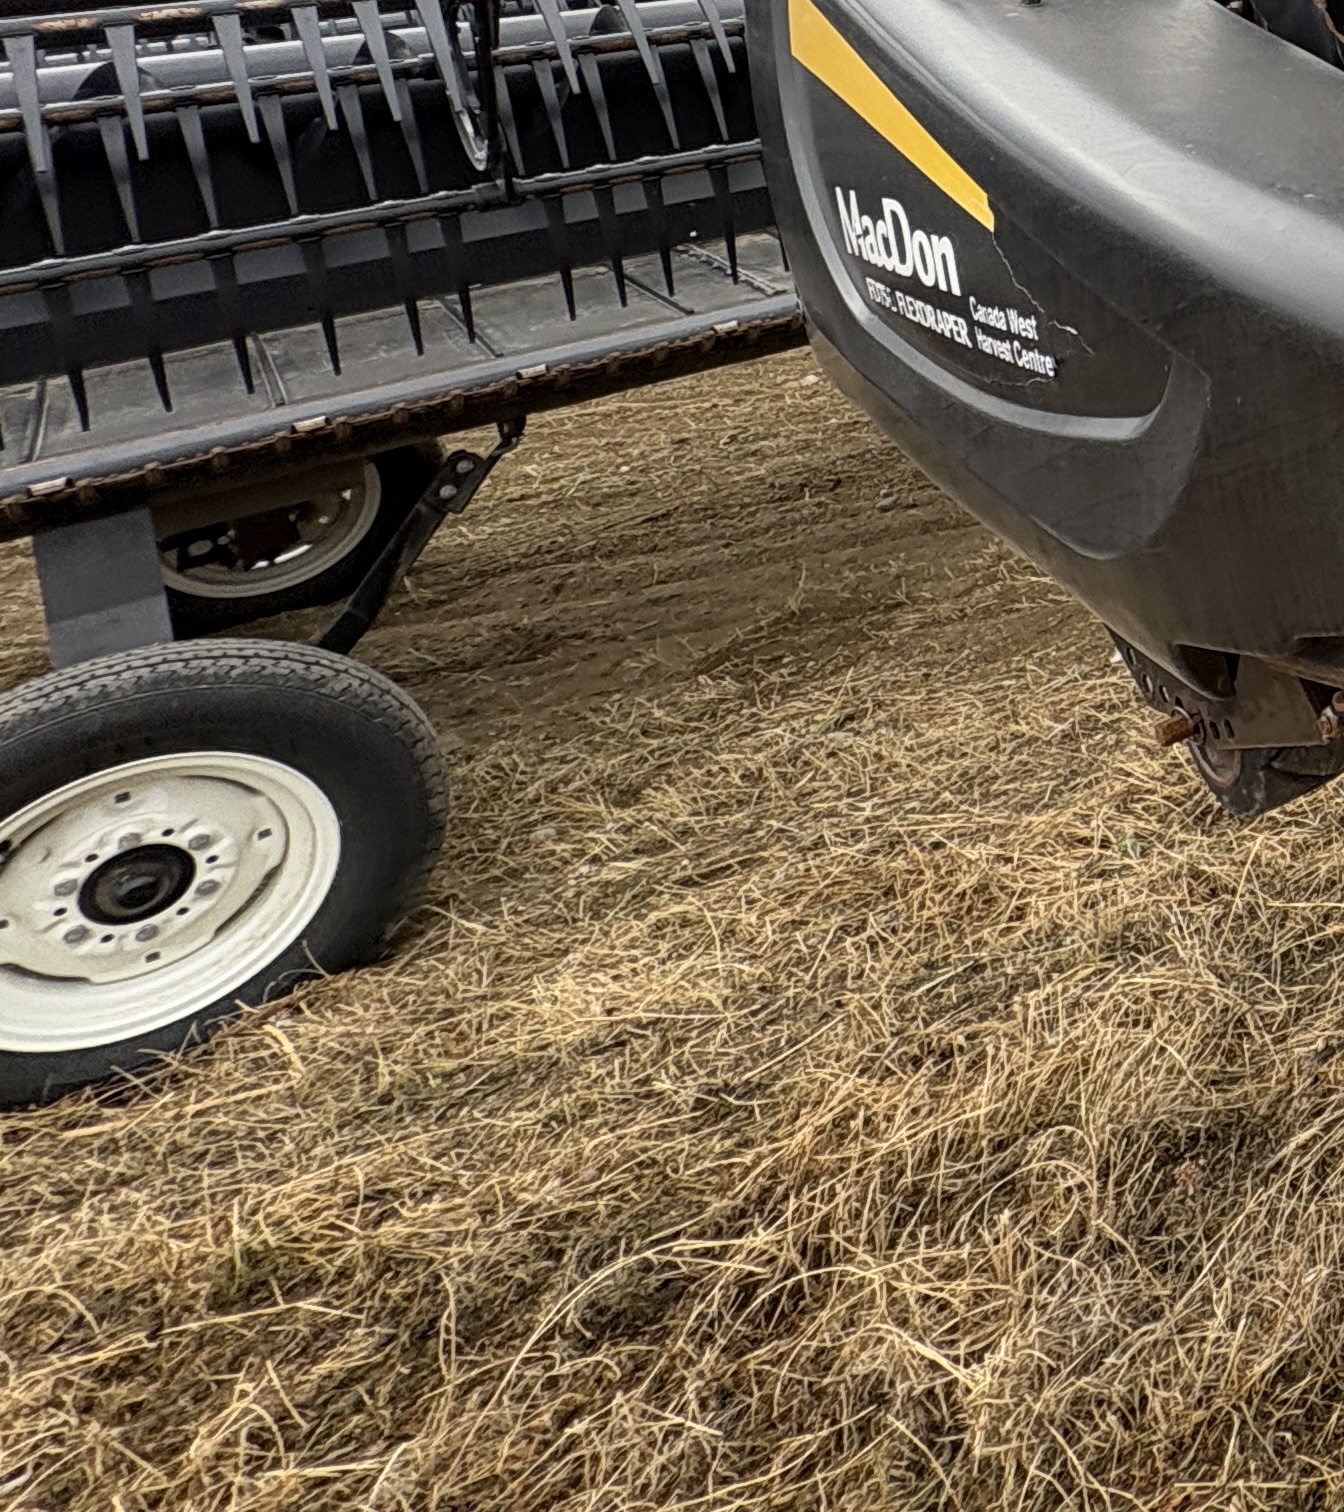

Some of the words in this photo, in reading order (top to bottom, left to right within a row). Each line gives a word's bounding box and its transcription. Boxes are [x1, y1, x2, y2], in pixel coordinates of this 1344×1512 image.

[835, 186, 961, 297] MacDon
[895, 290, 973, 349] FLEXDRAPER
[969, 295, 1007, 332] Canada
[1006, 307, 1039, 341] West
[974, 325, 1014, 364] Harvest
[1012, 339, 1056, 378] Centre
